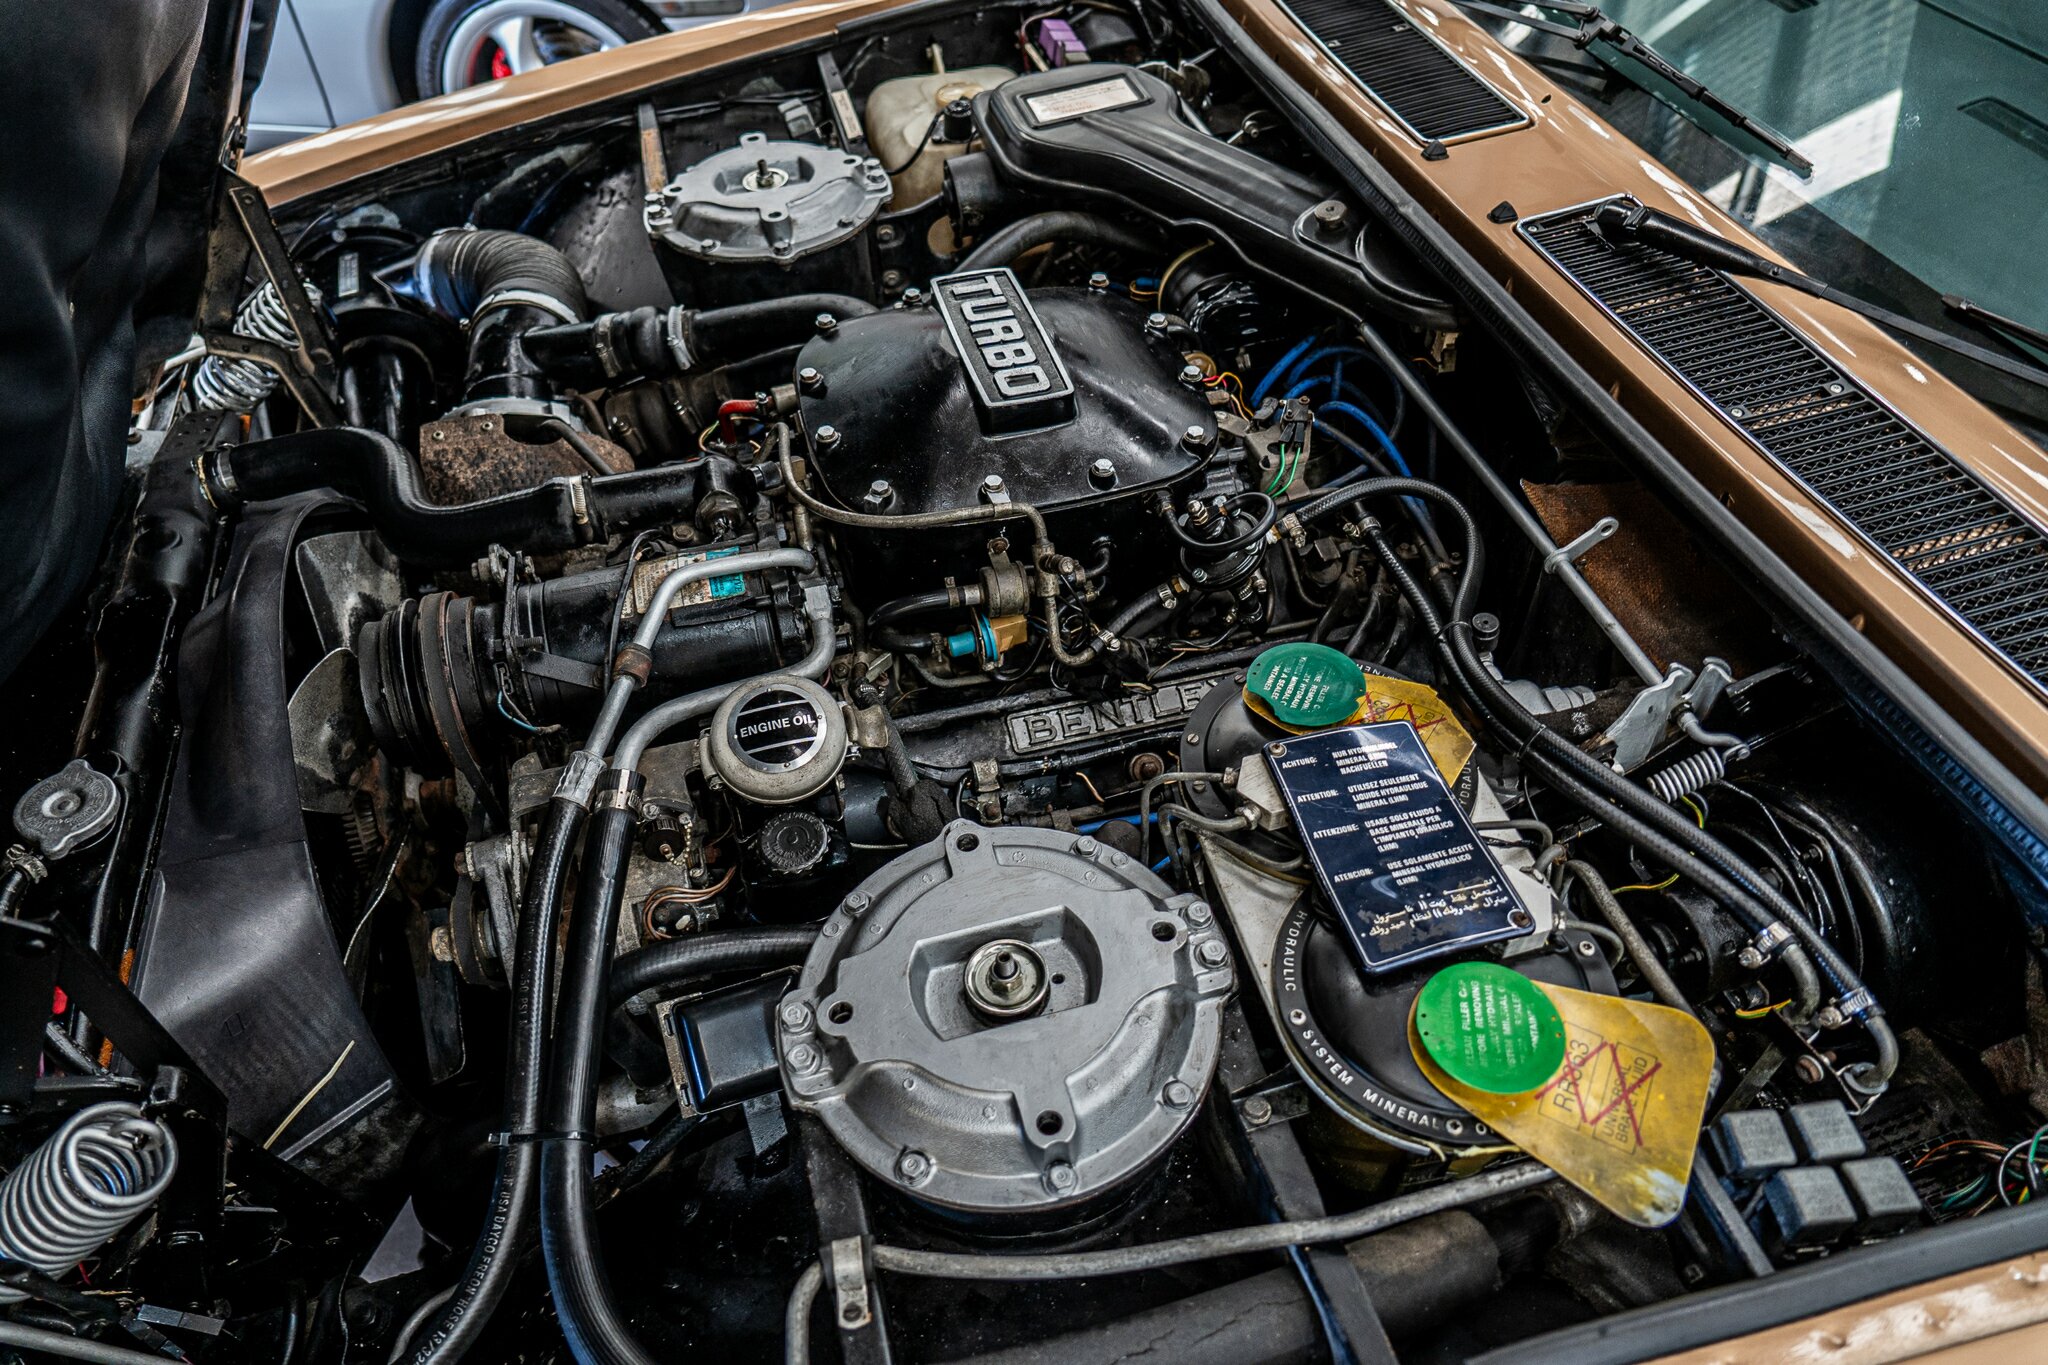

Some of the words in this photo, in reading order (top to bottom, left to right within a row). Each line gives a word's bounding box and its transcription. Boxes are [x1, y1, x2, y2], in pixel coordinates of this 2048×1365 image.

[952, 275, 1051, 397] TURBO
[1282, 676, 1299, 700] MINERAL
[1301, 684, 1318, 711] REMOVIN
[740, 718, 790, 738] ENGINE
[792, 714, 816, 726] OIL
[1282, 756, 1317, 769] ACHTUNG:
[1332, 749, 1348, 759] NUR
[1336, 755, 1367, 766] MINERAL
[1340, 760, 1389, 775] NACHFUELLEN
[1347, 781, 1379, 793] UTILISEZ
[1380, 773, 1419, 787] SEULEMENT
[1352, 790, 1381, 802] LIQUIDE
[1380, 781, 1428, 797] HYDRAULIQUE
[1458, 760, 1472, 805] YDRAU
[1297, 789, 1339, 803] ATTENTION:
[1356, 798, 1388, 811] MINERAL
[1388, 794, 1409, 805] (LHM)
[1364, 816, 1389, 828] USARE
[1390, 812, 1409, 823] SOLO
[1409, 807, 1436, 820] FLUIDO
[1369, 825, 1389, 837] BASE
[1390, 818, 1426, 833] MINERALE
[1426, 815, 1441, 824] PER
[1313, 823, 1359, 839] ATTENZIONE:
[1373, 828, 1416, 845] L'IMPIANTO
[1416, 820, 1454, 835] IDRAULICO
[1377, 842, 1399, 853] (LHM)
[1387, 861, 1402, 871] USE
[1402, 848, 1447, 867] SOLAMENTE
[1447, 843, 1474, 855] ACEITE
[1334, 868, 1374, 883] ATENCION:
[1391, 866, 1426, 879] MINERAL
[1425, 853, 1472, 871] HYDRAULICO
[1396, 875, 1419, 886] (LHM)
[1283, 909, 1308, 992] HYDRAULIC
[1470, 980, 1484, 1029] REMOVING
[1460, 1001, 1471, 1031] FILLER
[1302, 1029, 1354, 1085] SYSTEM
[1362, 1088, 1441, 1130] MINERAL
[498, 1191, 511, 1213] USA
[484, 1215, 506, 1254] DAYCO
